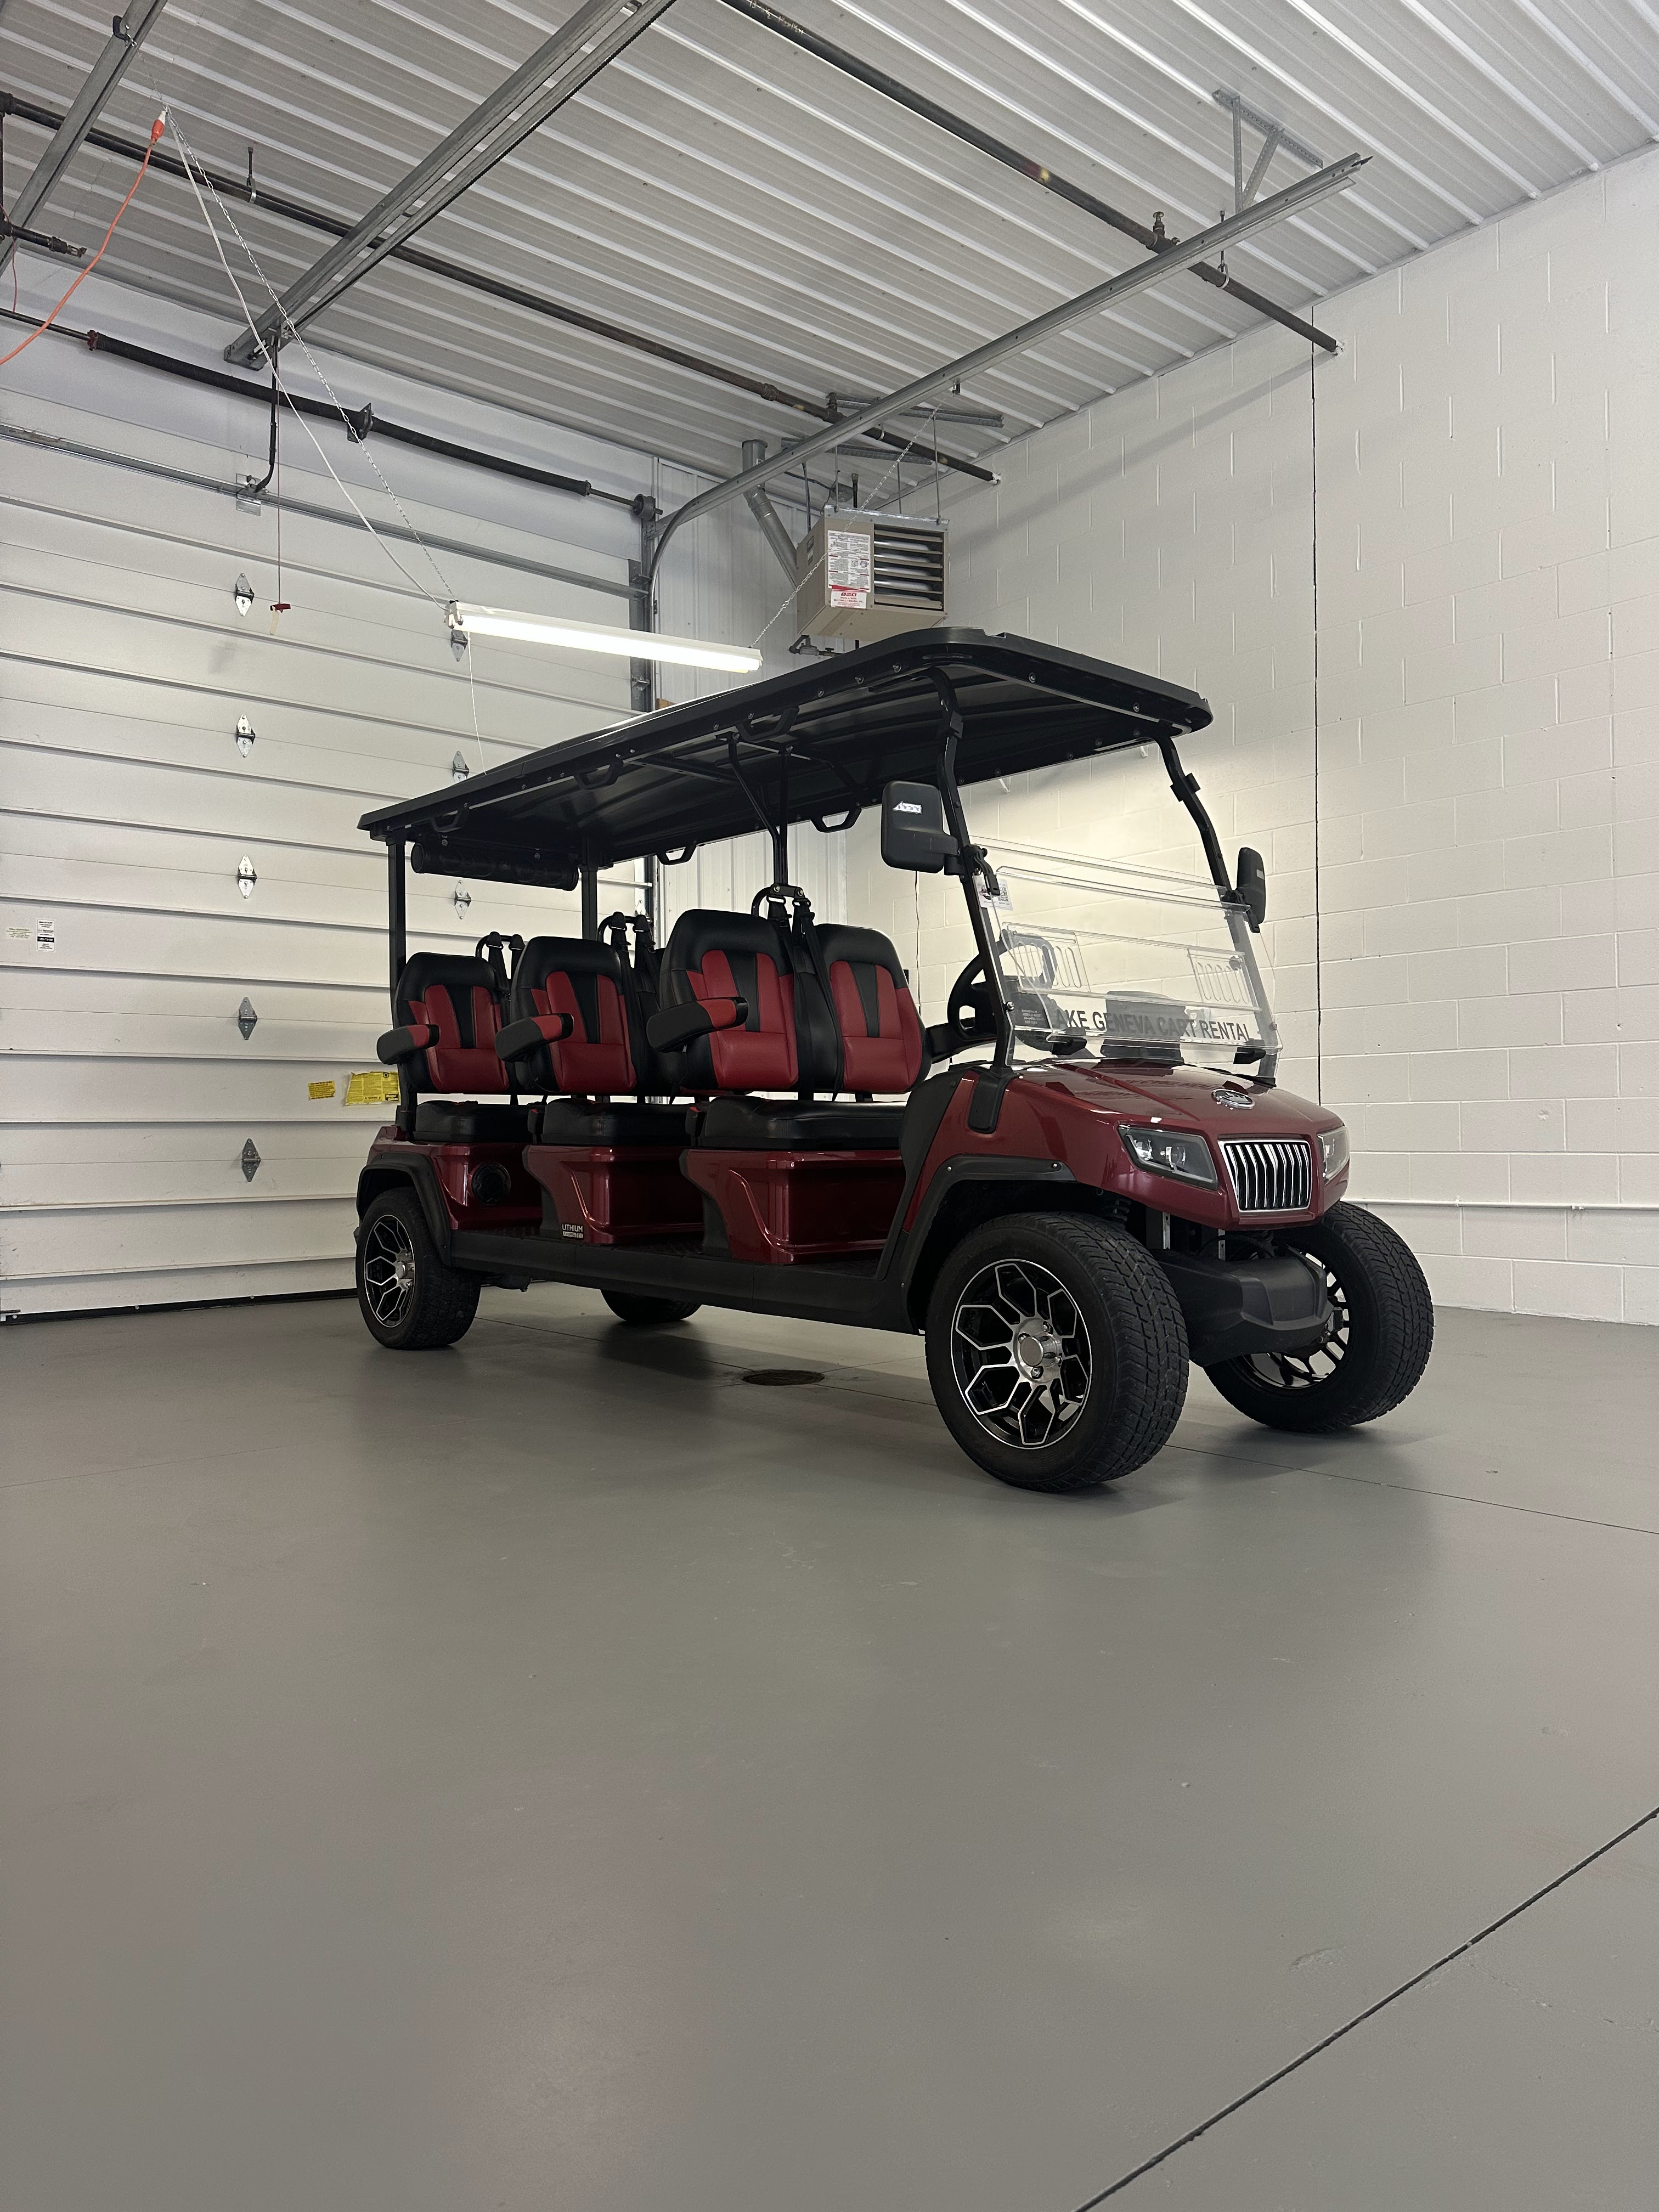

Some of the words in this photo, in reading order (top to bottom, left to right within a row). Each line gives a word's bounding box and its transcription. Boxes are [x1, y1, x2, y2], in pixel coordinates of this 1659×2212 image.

[1092, 1011, 1156, 1035] GENEVA
[1158, 1016, 1194, 1037] CART
[1199, 1020, 1255, 1041] RENTAL
[562, 1223, 583, 1232] LITHIUM
